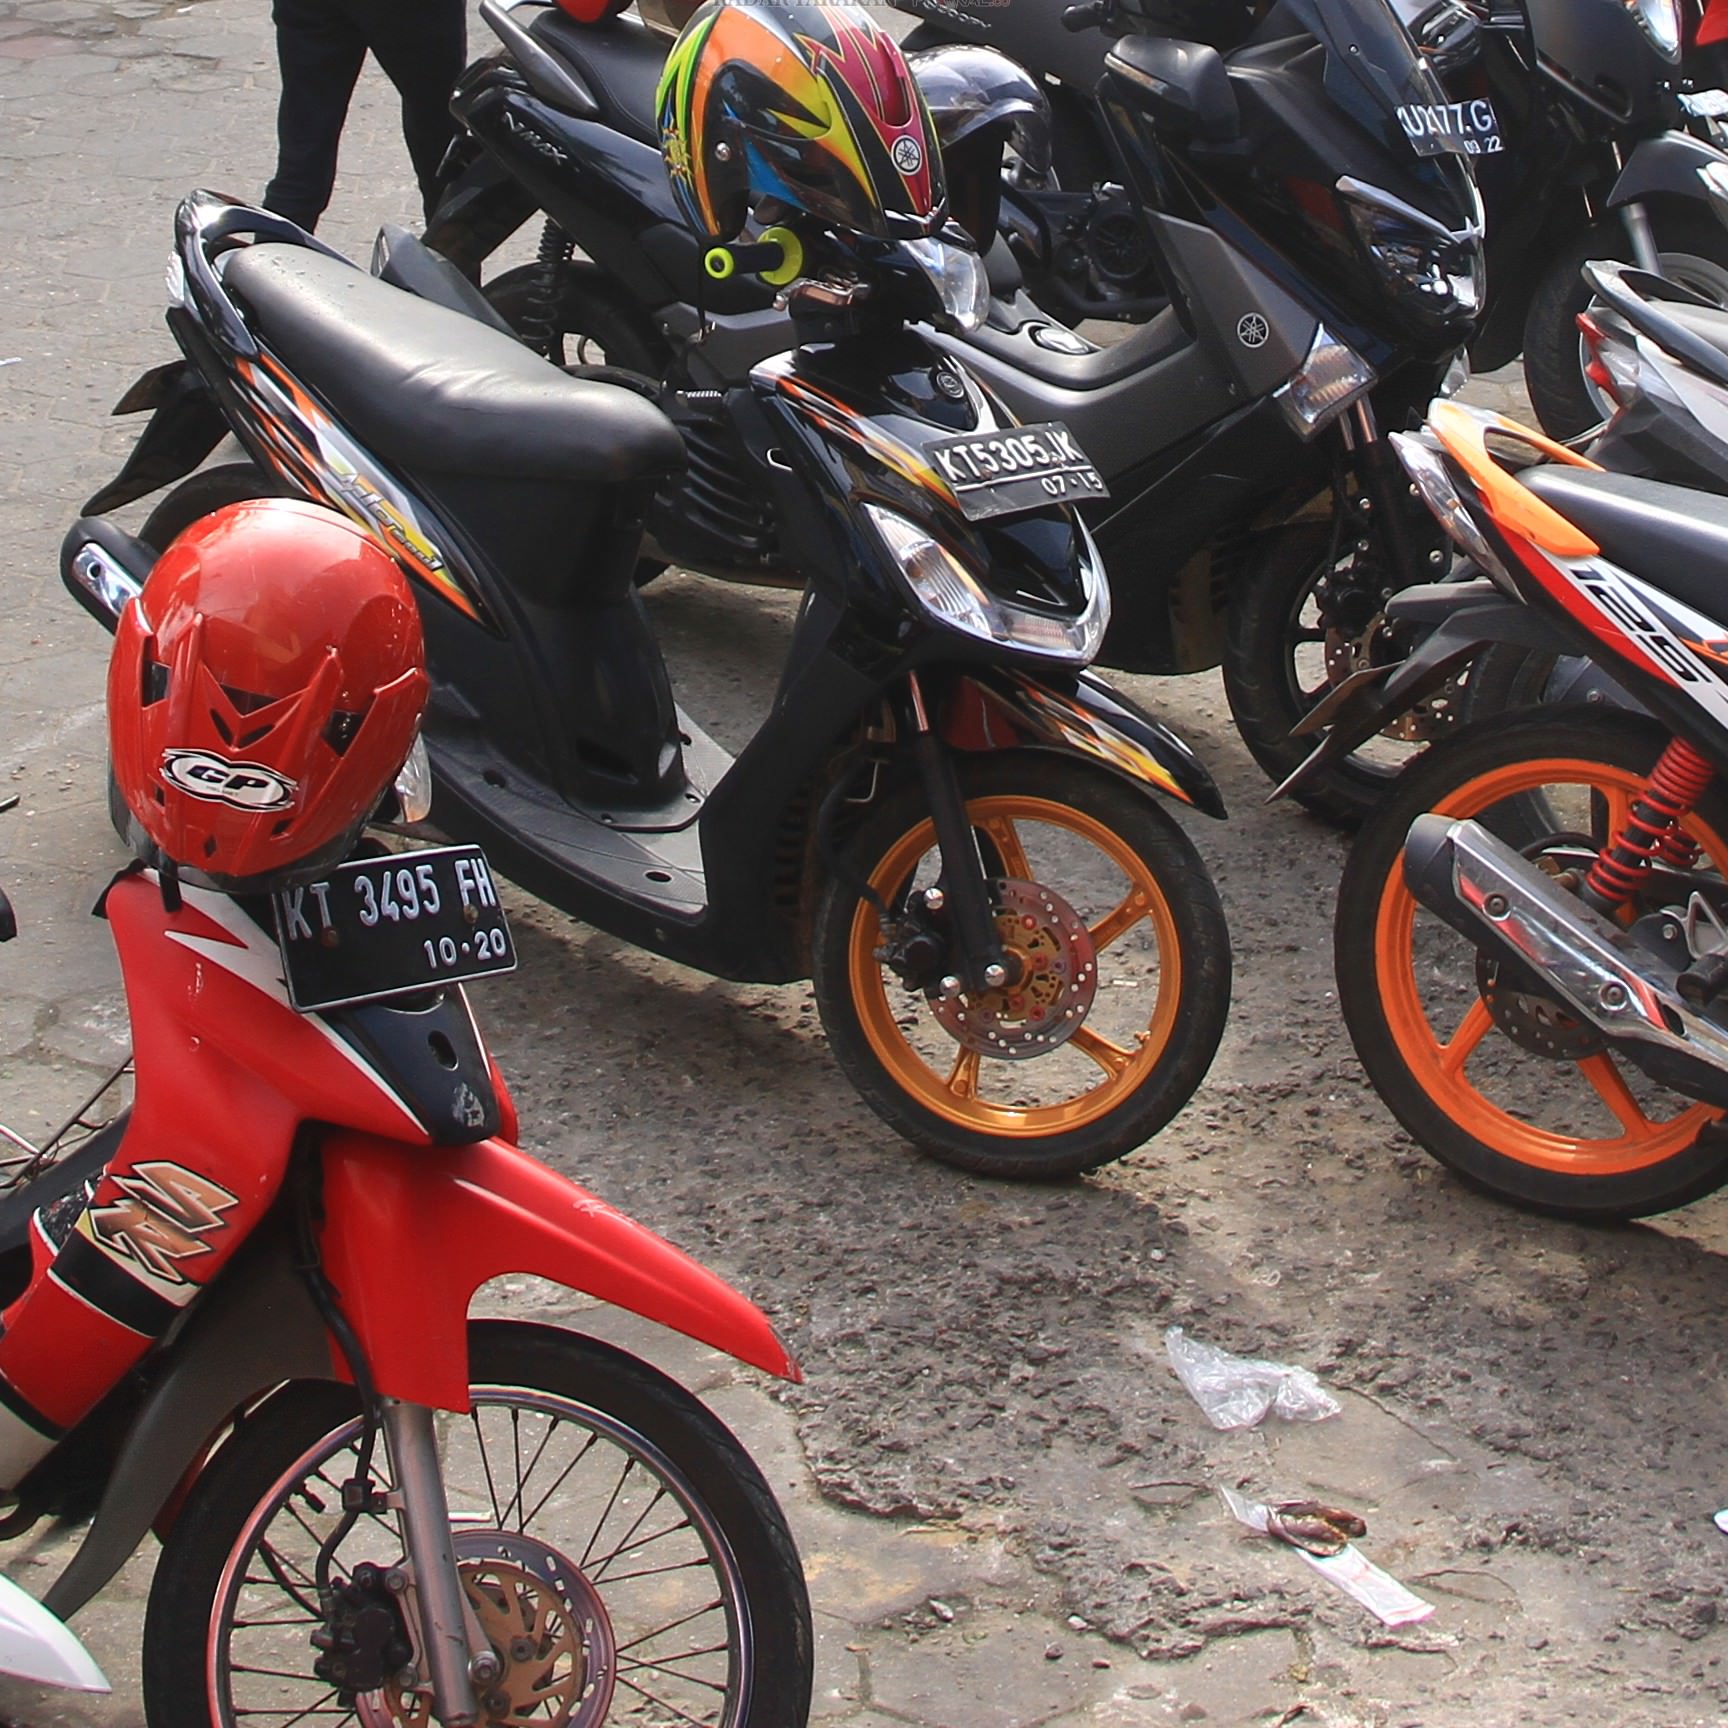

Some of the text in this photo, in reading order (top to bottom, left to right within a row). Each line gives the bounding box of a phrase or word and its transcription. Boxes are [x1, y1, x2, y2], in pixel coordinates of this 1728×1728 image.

[186, 763, 272, 792] GP
[282, 857, 497, 941] KT 3495 FH
